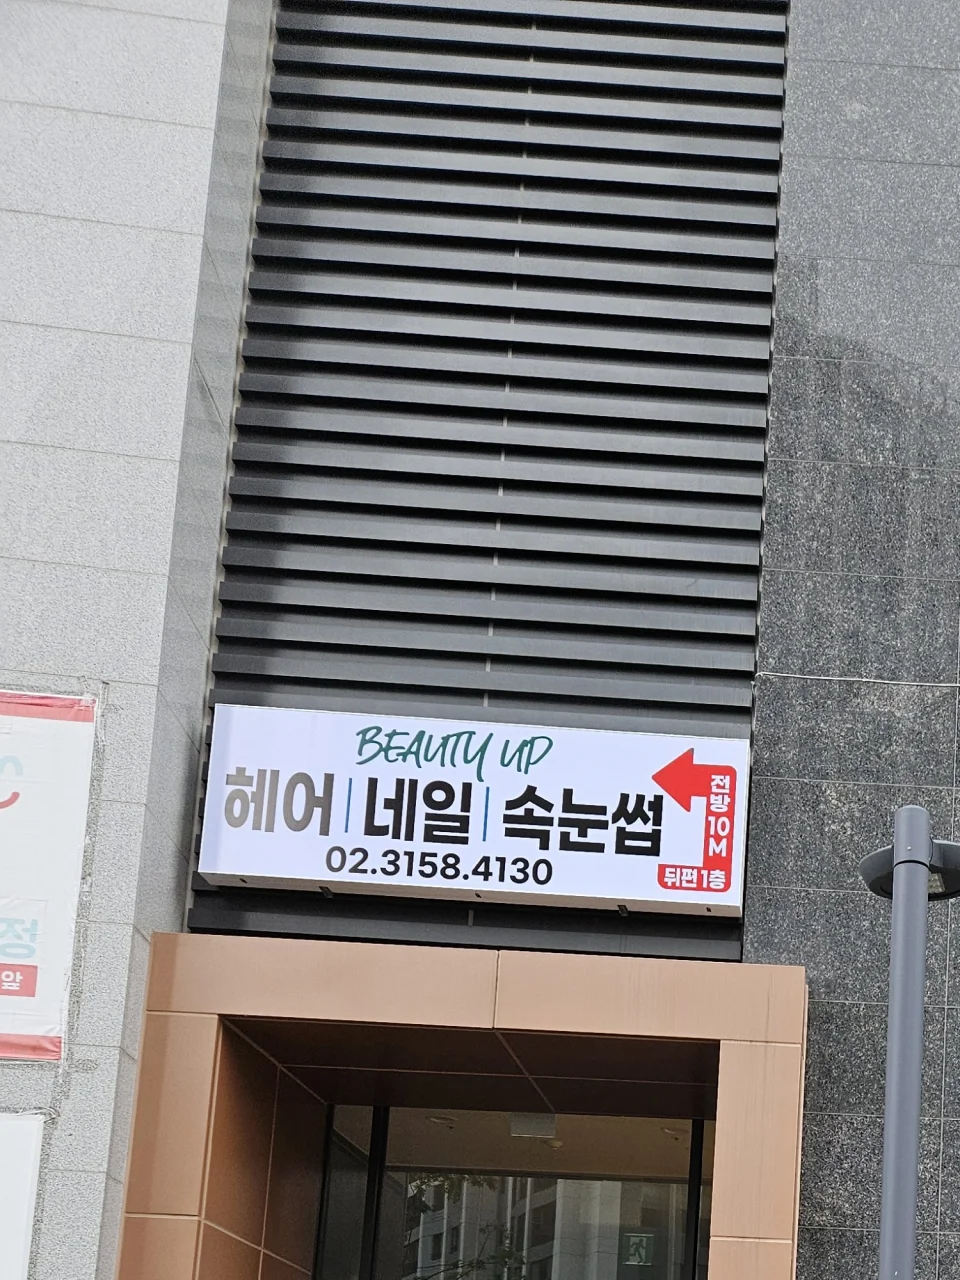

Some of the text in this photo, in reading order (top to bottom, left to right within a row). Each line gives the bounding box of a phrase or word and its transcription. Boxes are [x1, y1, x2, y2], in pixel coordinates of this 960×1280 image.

[355, 725, 554, 782] BEAUTY UP
[224, 766, 664, 858] 헤어 네일 속눈썹
[710, 774, 731, 813] 전방
[325, 845, 554, 885] 02.3158.4130
[663, 867, 726, 890] 뒤편 1층
